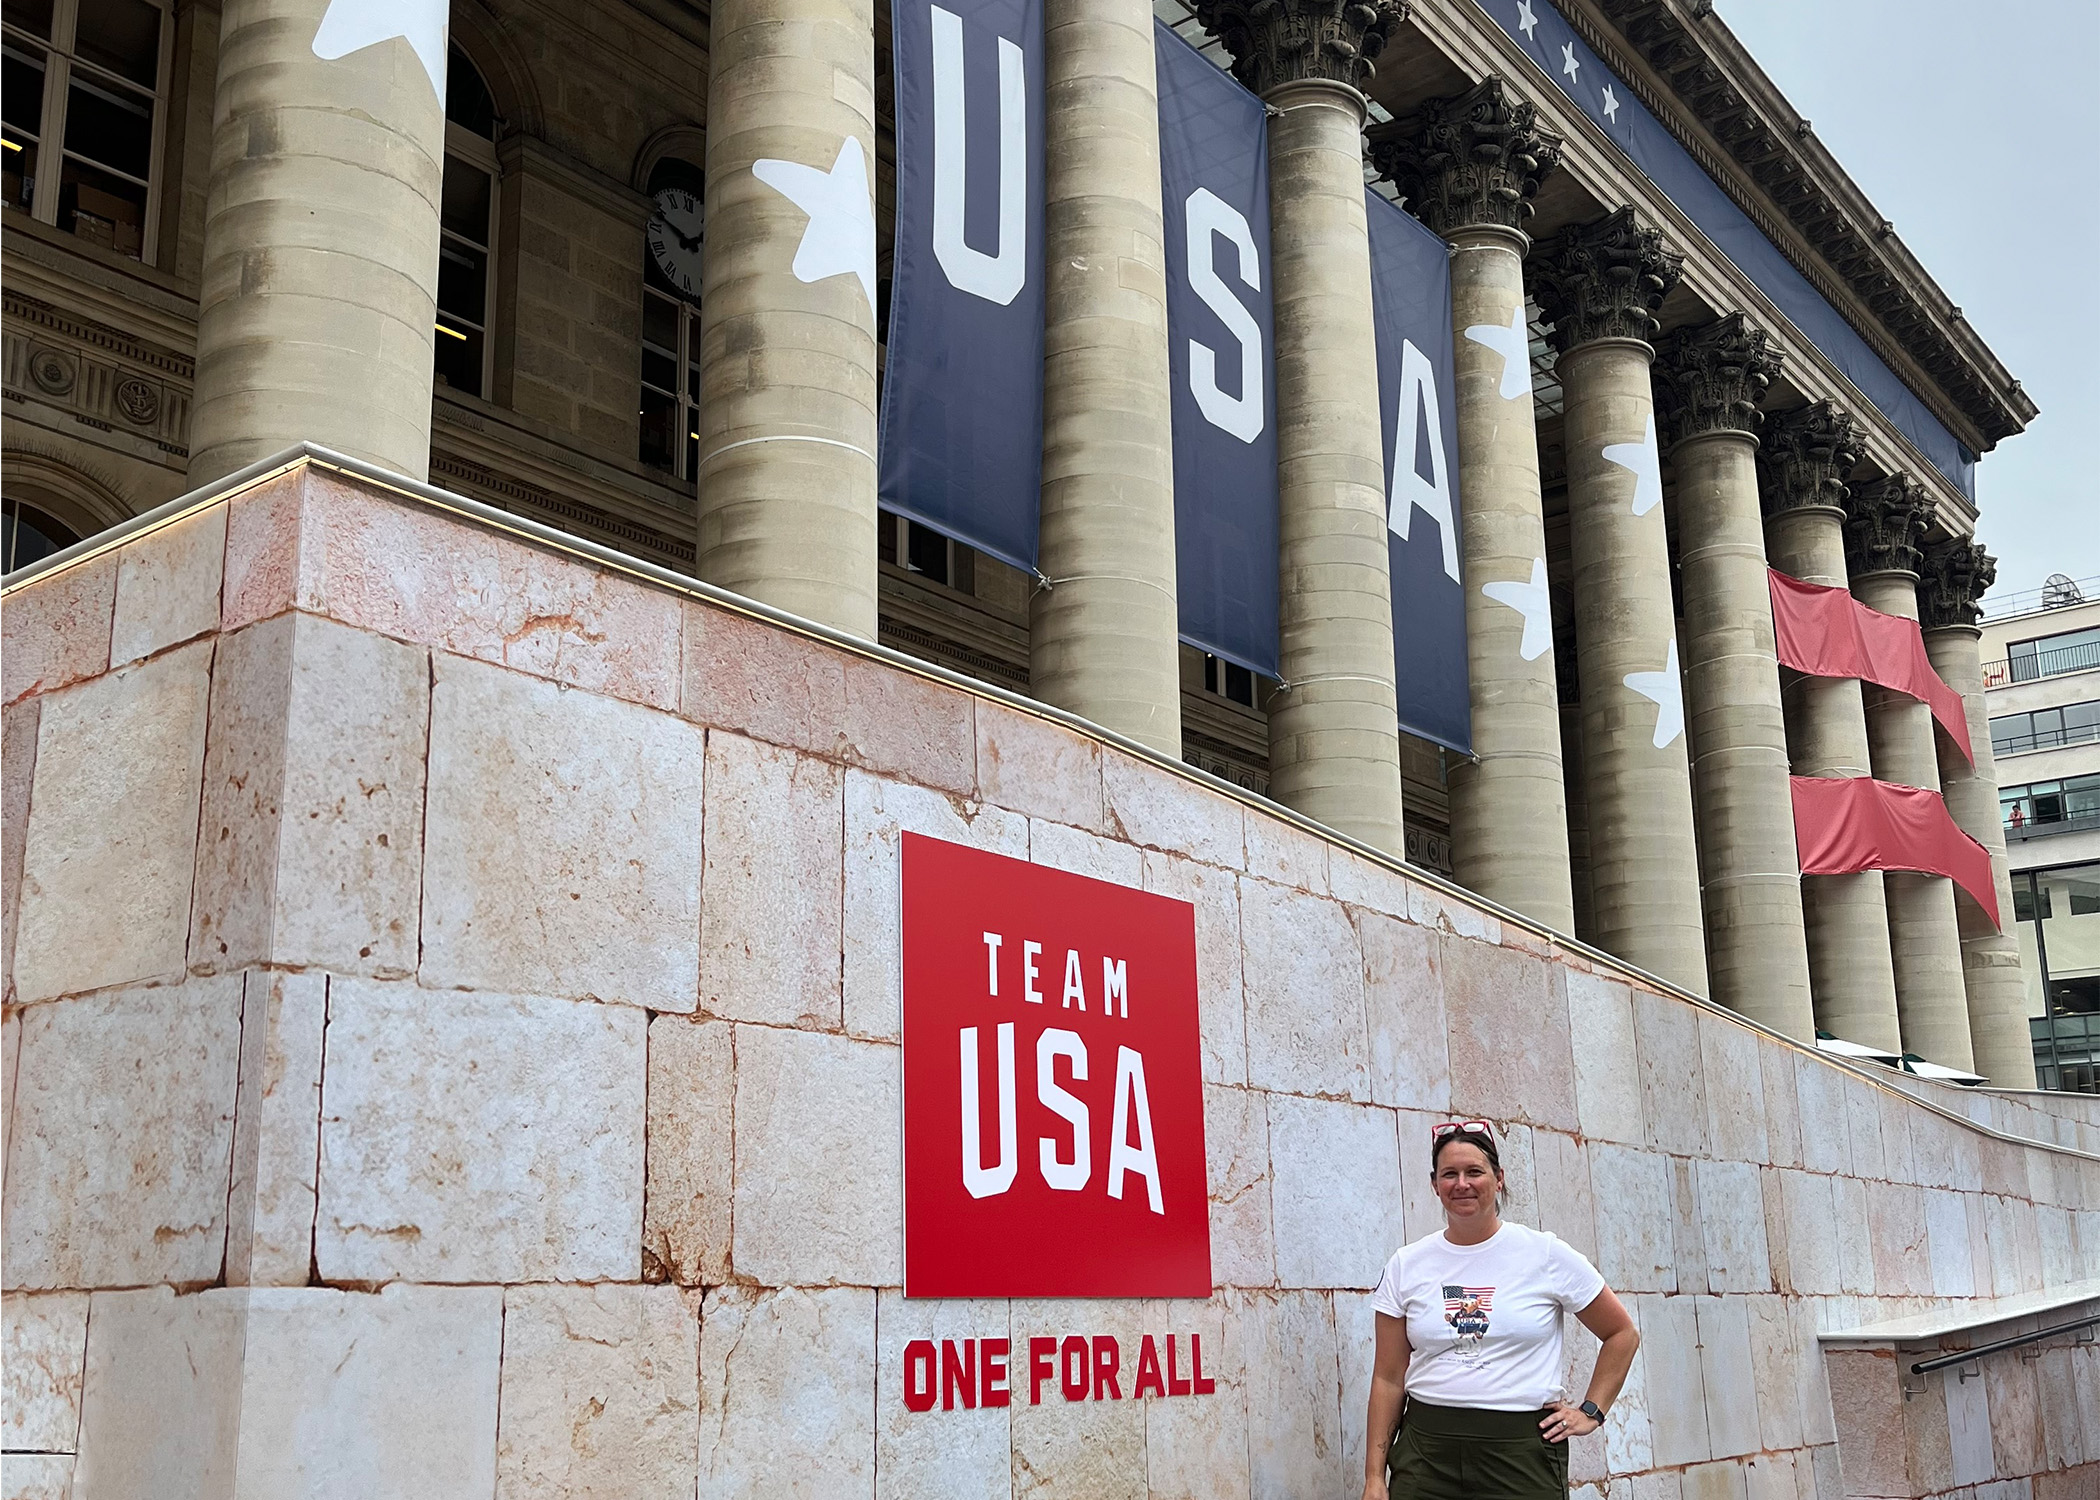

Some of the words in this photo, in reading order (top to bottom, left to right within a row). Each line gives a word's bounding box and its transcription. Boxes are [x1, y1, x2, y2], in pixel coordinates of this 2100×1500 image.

[683, 195, 694, 214] XII
[983, 931, 1128, 1019] TEAM
[960, 1022, 1165, 1216] USA
[903, 1338, 1011, 1413] ONE
[1029, 1335, 1123, 1406] FOR
[1133, 1333, 1216, 1400] ALL
